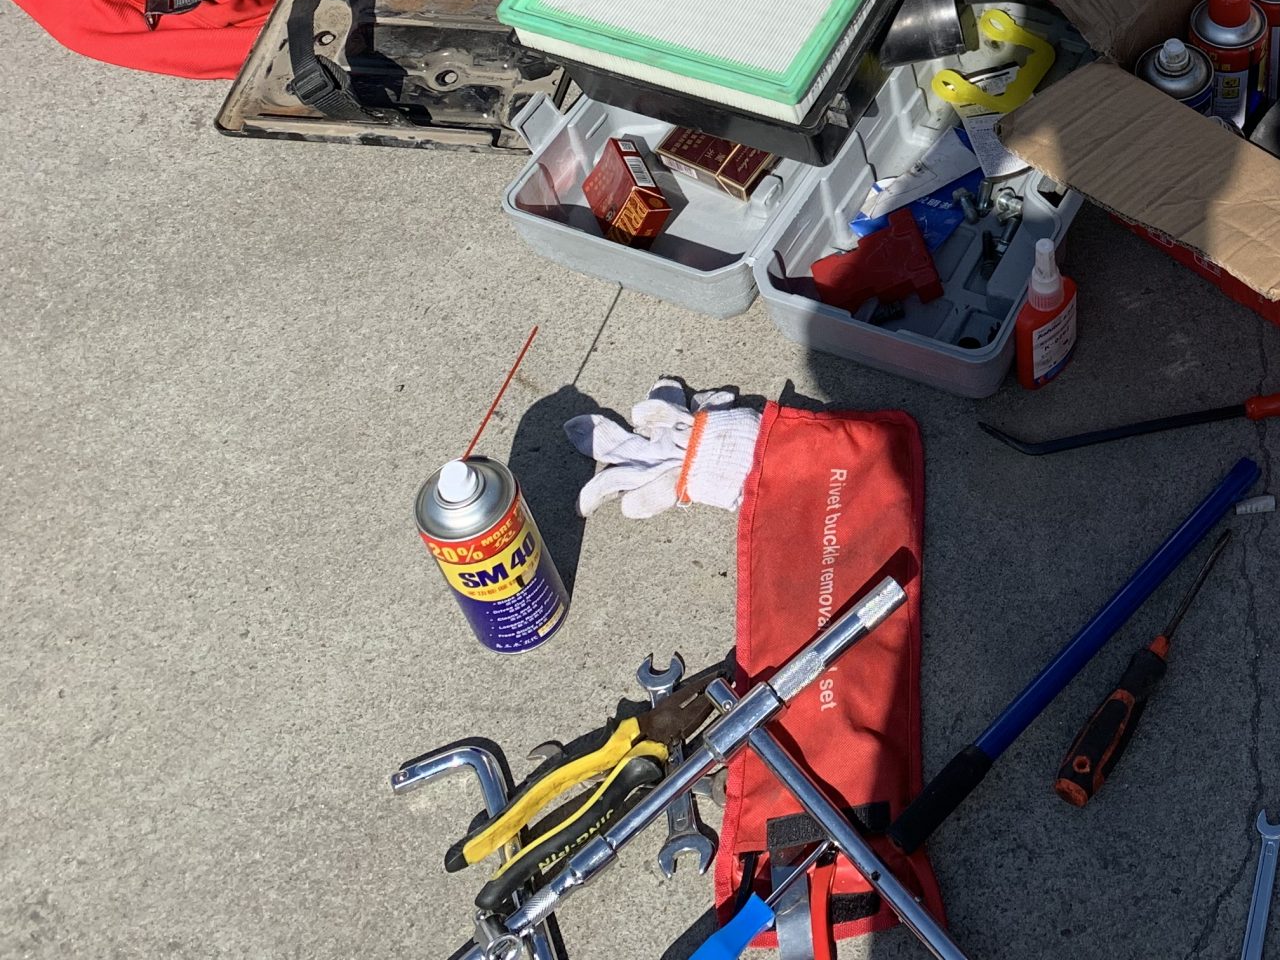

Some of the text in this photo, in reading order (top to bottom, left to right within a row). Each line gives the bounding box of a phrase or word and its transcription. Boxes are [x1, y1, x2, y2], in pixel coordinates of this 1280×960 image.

[826, 468, 848, 512] Rivet
[428, 541, 484, 564] 20%
[481, 518, 514, 547] MORE
[458, 562, 510, 589] SM
[510, 531, 536, 571] 40
[822, 512, 841, 566] buckle
[817, 567, 834, 630] remova
[819, 679, 837, 712] set
